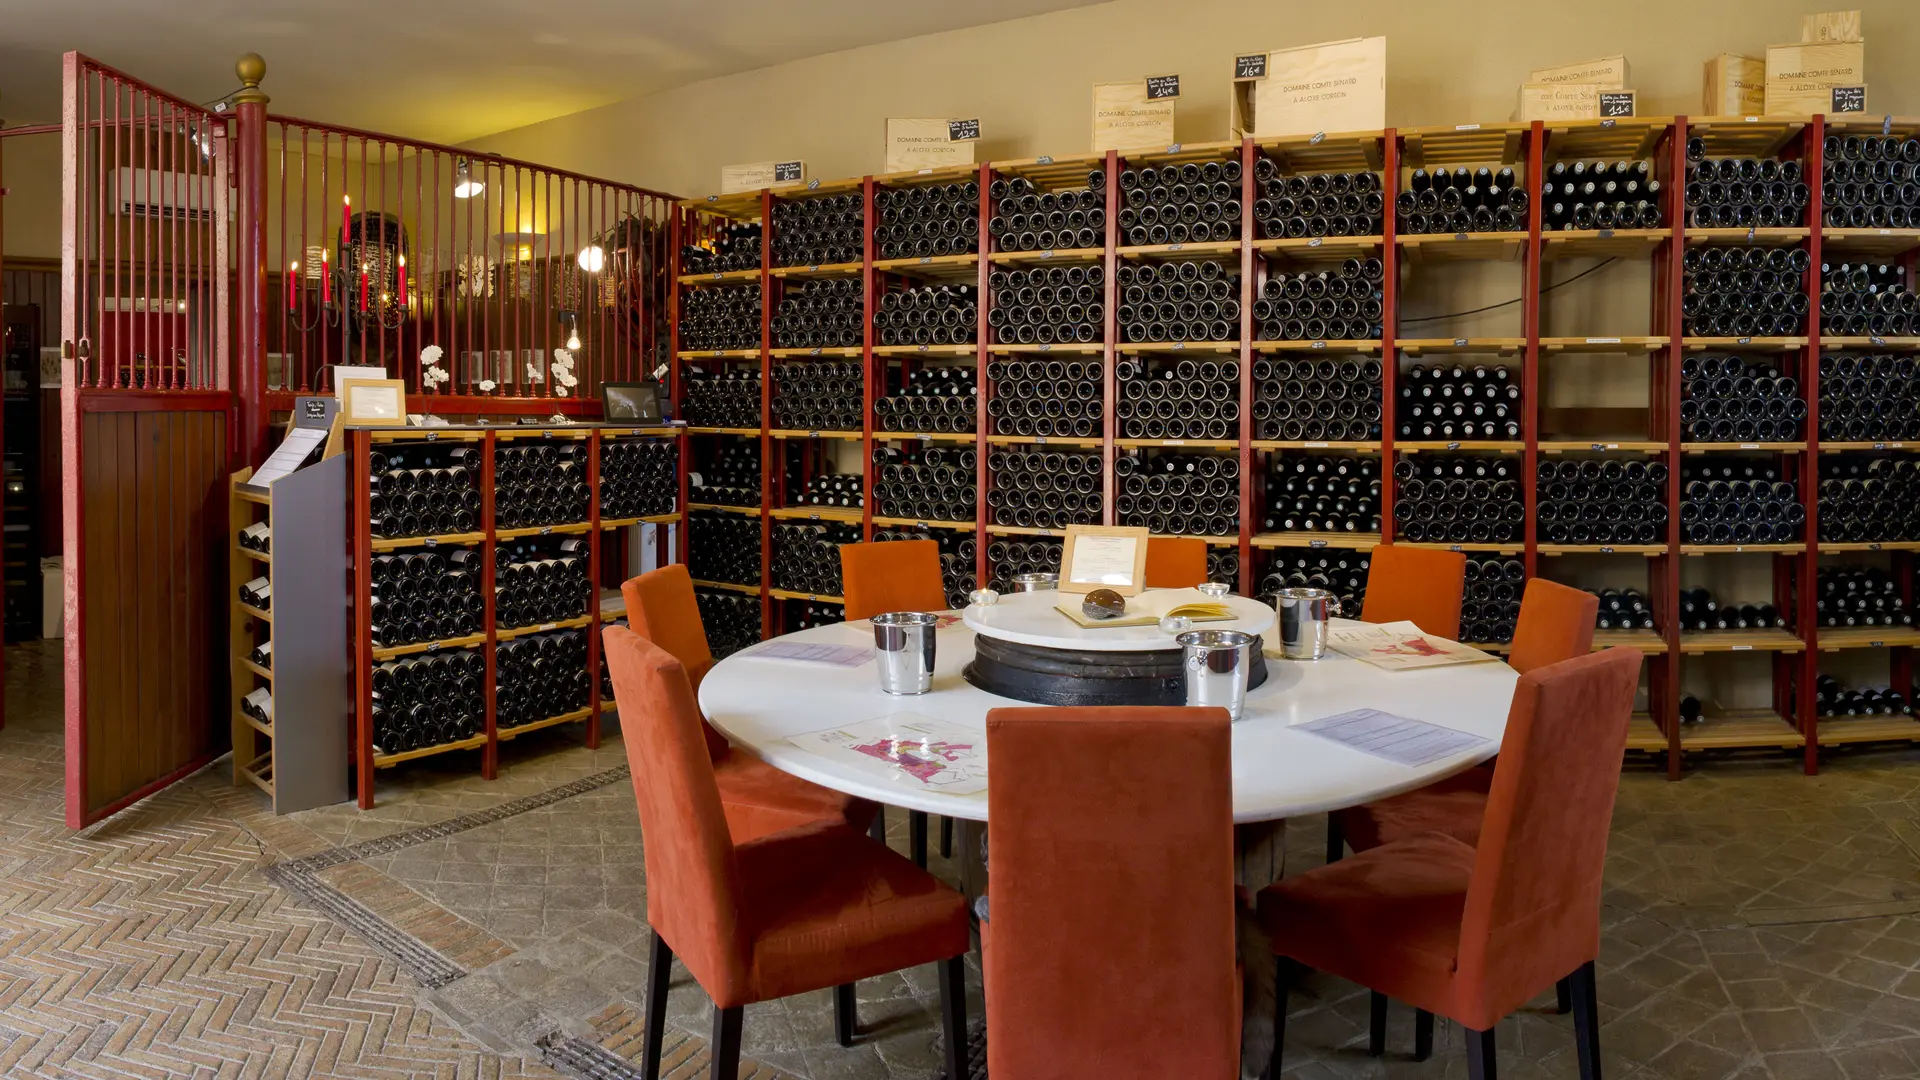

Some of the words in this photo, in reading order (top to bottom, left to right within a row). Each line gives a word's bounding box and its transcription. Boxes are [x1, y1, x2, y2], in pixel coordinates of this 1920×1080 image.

[1241, 66, 1260, 77] 16€
[1569, 72, 1588, 80] COMTE
[1590, 68, 1612, 76] SENARD
[1779, 72, 1806, 80] DOMAINE
[1830, 68, 1853, 76] SENARD
[1284, 84, 1310, 92] DOMAINE
[1312, 81, 1332, 89] COMTE
[1334, 78, 1356, 86] SENARD
[1155, 87, 1174, 97] 14€
[1321, 92, 1346, 100] CORTON
[1580, 91, 1596, 100] SENA
[1609, 105, 1630, 116] 11€
[1841, 100, 1860, 112] 14€
[957, 129, 976, 139] 12€
[784, 171, 795, 180] 8€
